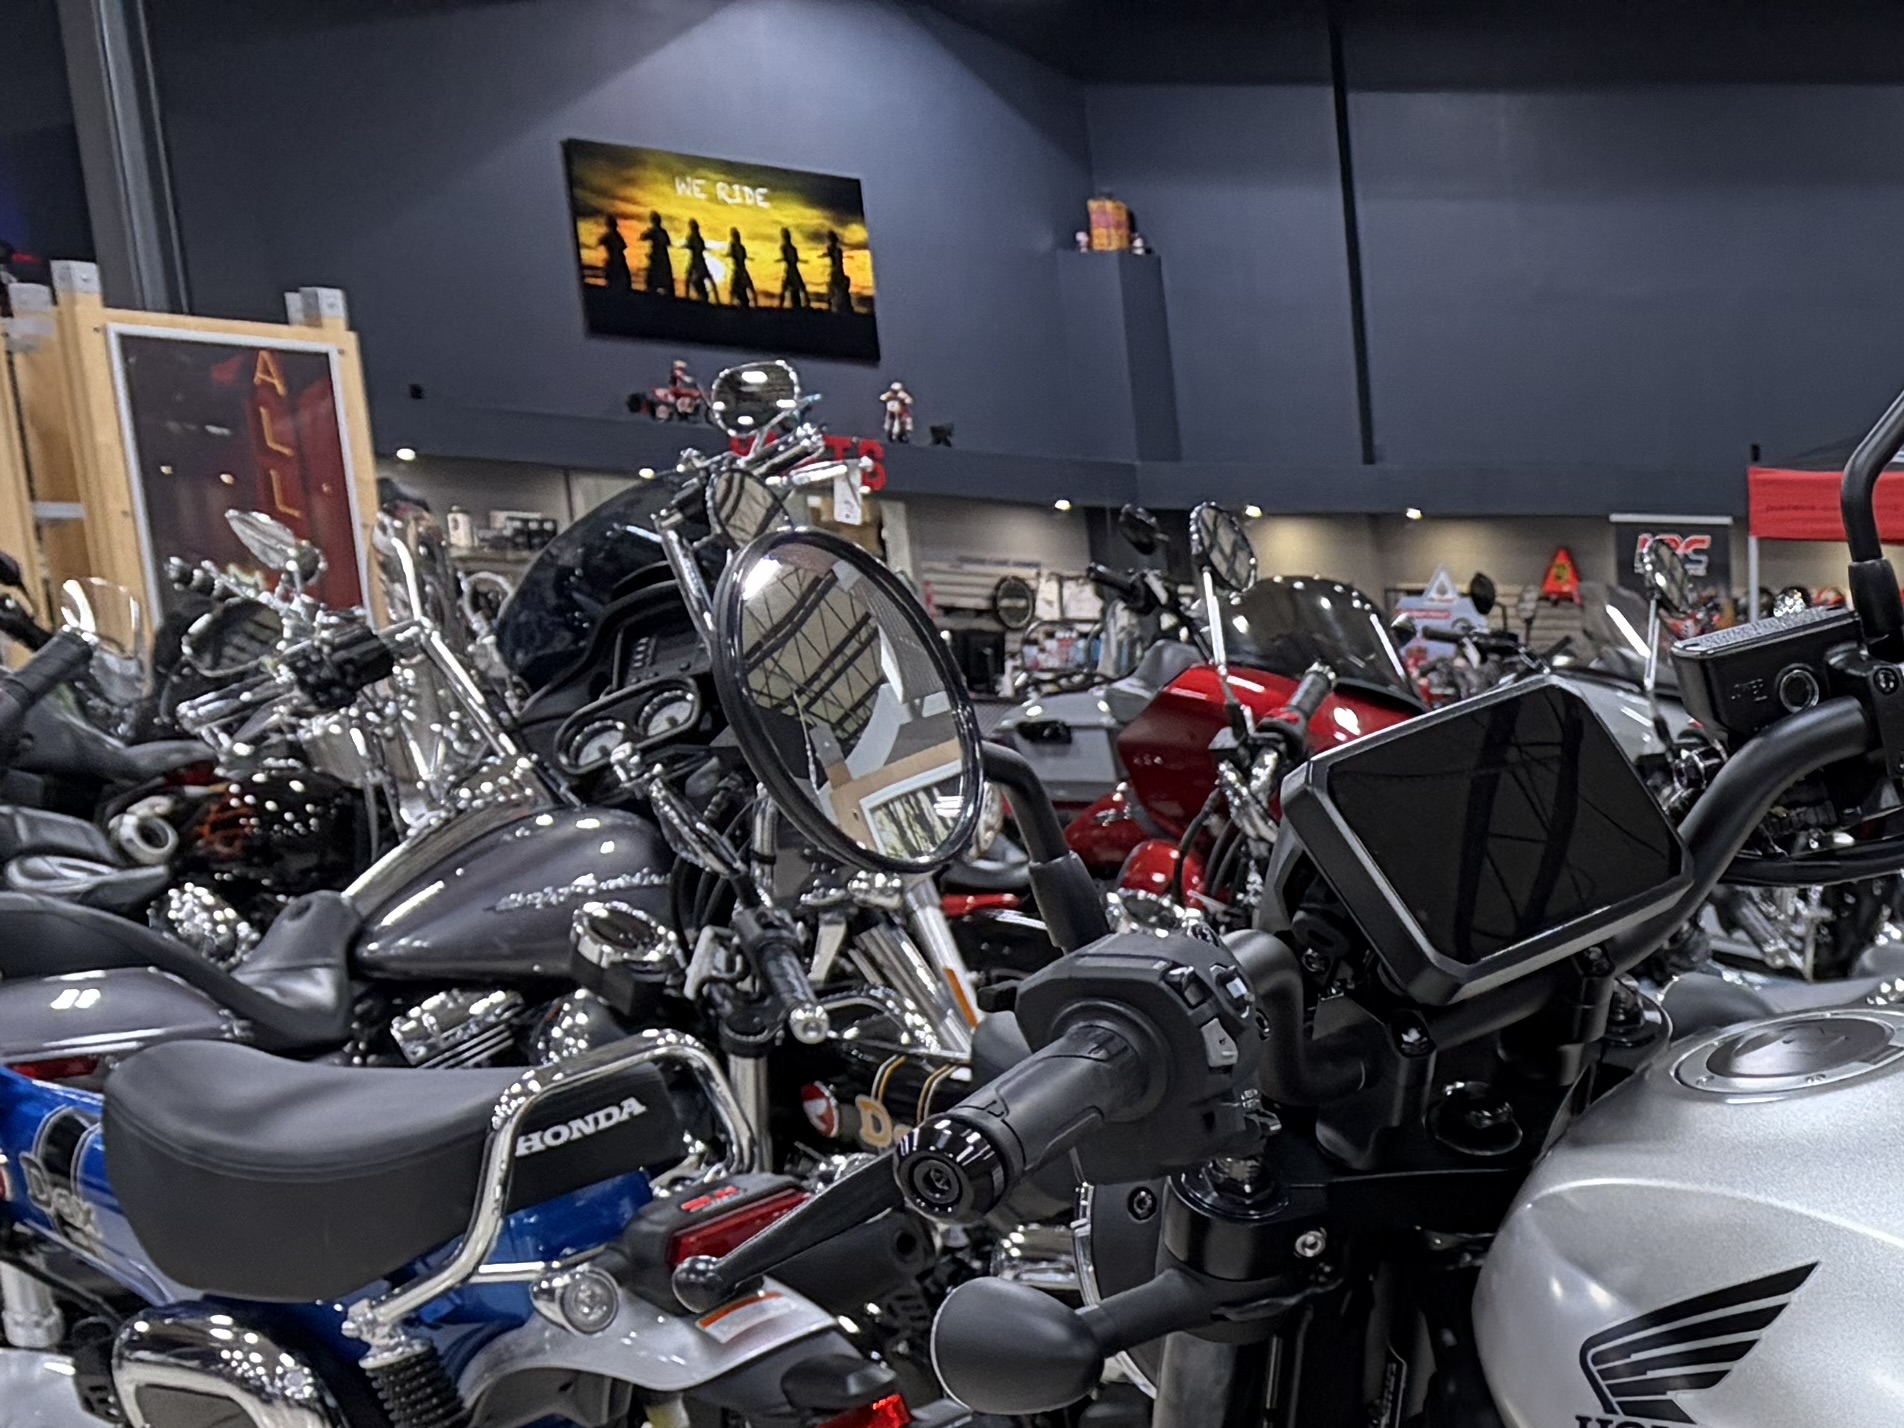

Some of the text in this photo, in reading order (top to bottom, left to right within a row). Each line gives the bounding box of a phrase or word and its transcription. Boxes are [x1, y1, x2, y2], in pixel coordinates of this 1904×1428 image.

[675, 177, 770, 208] WE RIDE
[516, 1097, 647, 1157] HONDA
